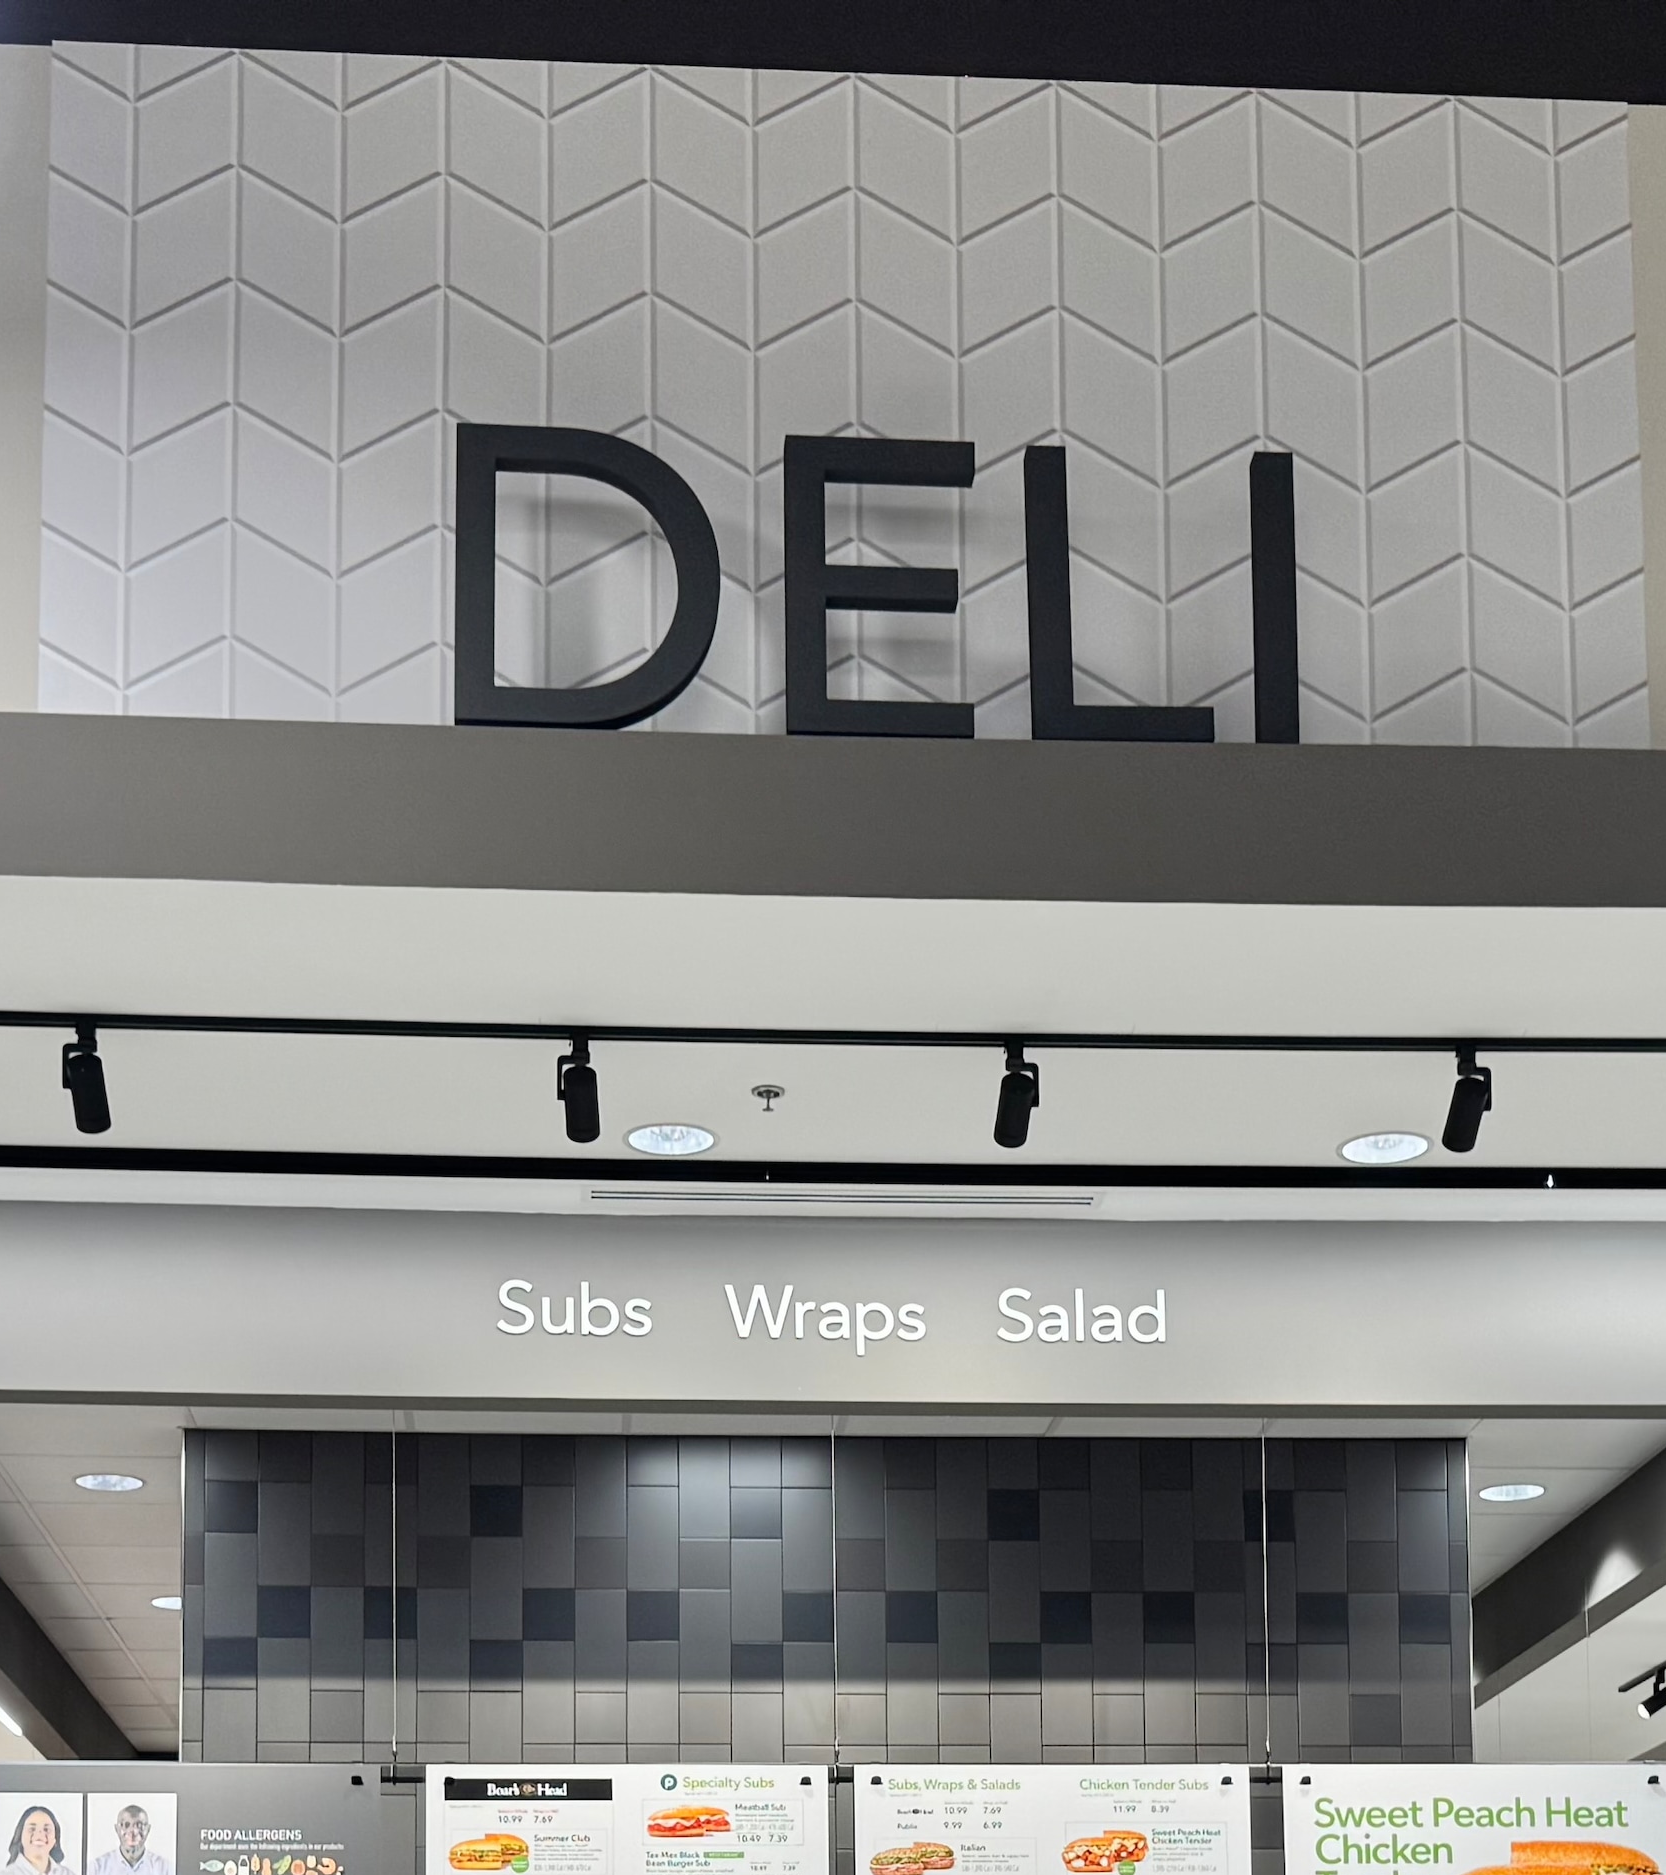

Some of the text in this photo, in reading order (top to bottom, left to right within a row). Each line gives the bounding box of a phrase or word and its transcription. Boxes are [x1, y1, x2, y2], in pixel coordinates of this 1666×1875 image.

[454, 422, 1300, 745] DELI
[496, 1279, 1167, 1357] Subs Wraps Salad
[537, 1783, 568, 1797] Head
[682, 1776, 775, 1791] Specialty Subs
[888, 1779, 1021, 1793] Subs, Wraps & Salads
[1079, 1779, 1210, 1791] Chicken Tender Subs
[734, 1803, 786, 1812] Meatball Sub
[1314, 1796, 1629, 1829] Sweet Peach Heat
[498, 1815, 553, 1824] 10.99 7.69
[200, 1829, 303, 1841] FOOD ALLERGENS
[1315, 1833, 1454, 1865] Chicken
